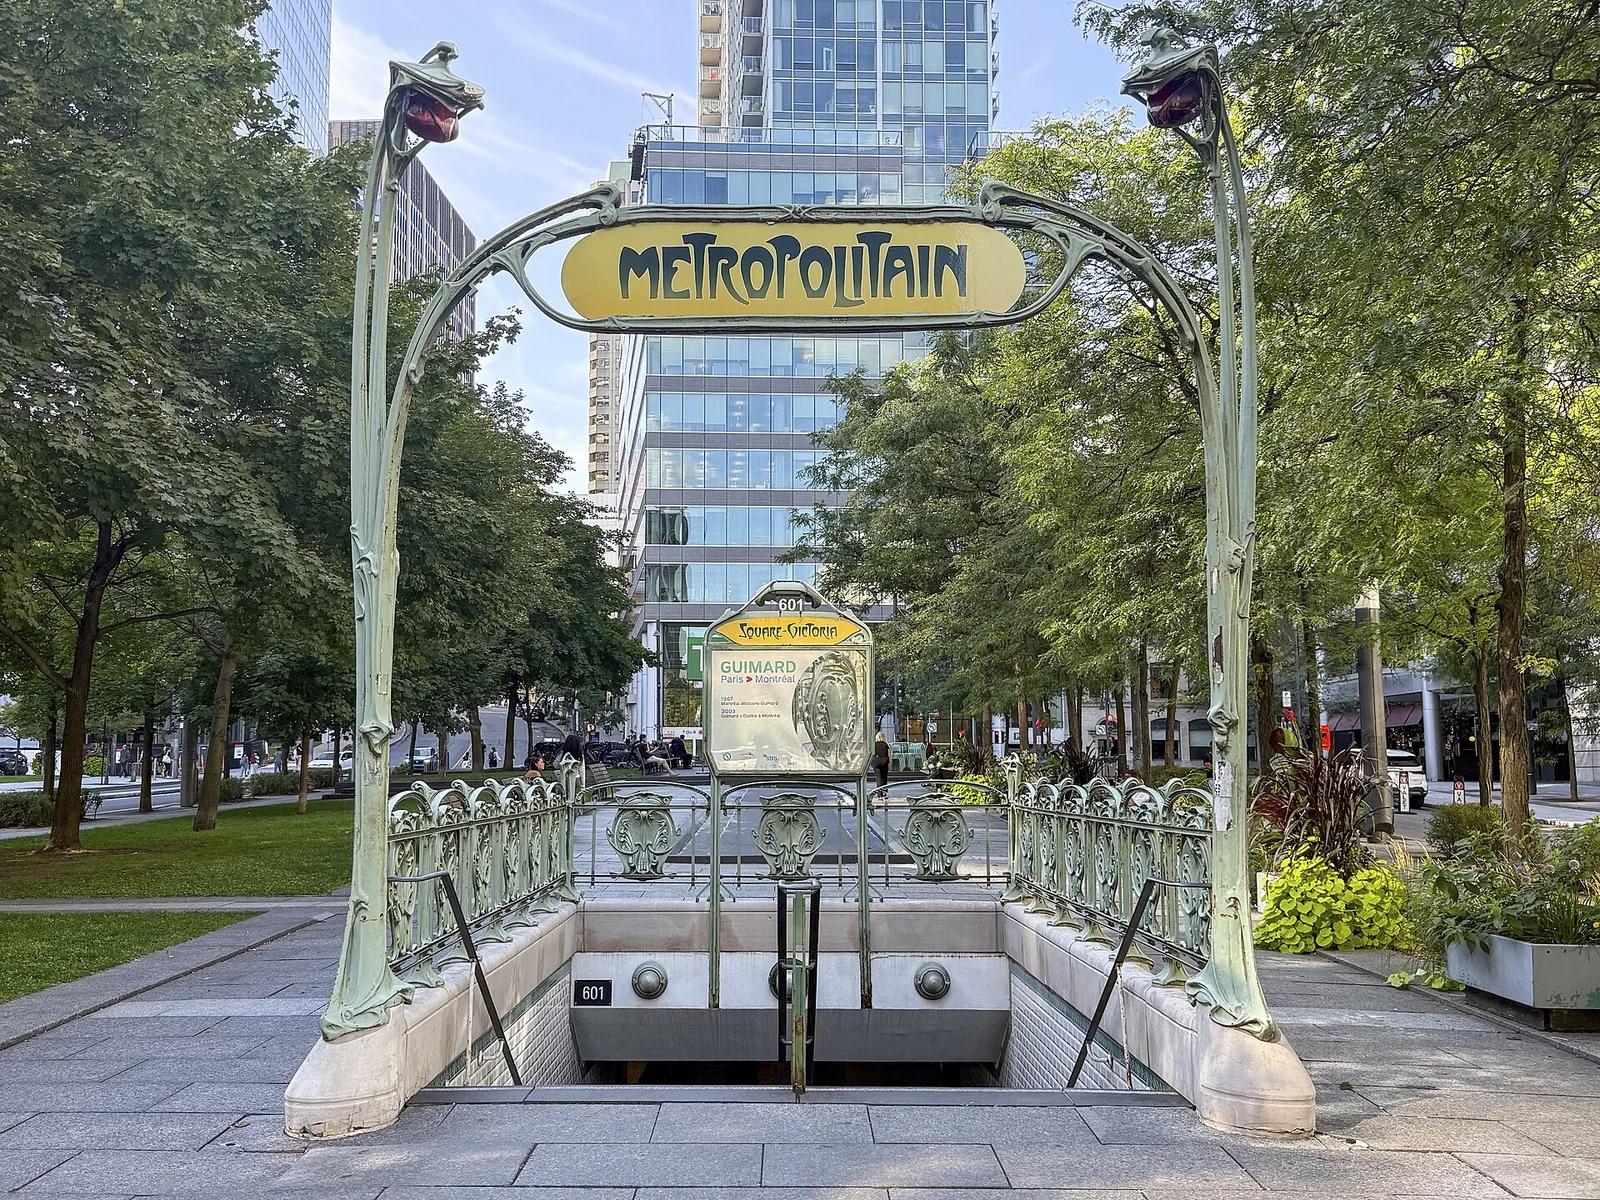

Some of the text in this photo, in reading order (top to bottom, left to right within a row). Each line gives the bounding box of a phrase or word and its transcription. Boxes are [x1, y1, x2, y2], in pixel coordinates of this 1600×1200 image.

[619, 231, 968, 308] METROPOLITAIN
[778, 598, 803, 611] 601
[720, 660, 797, 674] GUIMARD
[720, 674, 796, 684] Paris Montréal
[582, 985, 604, 1000] 601
